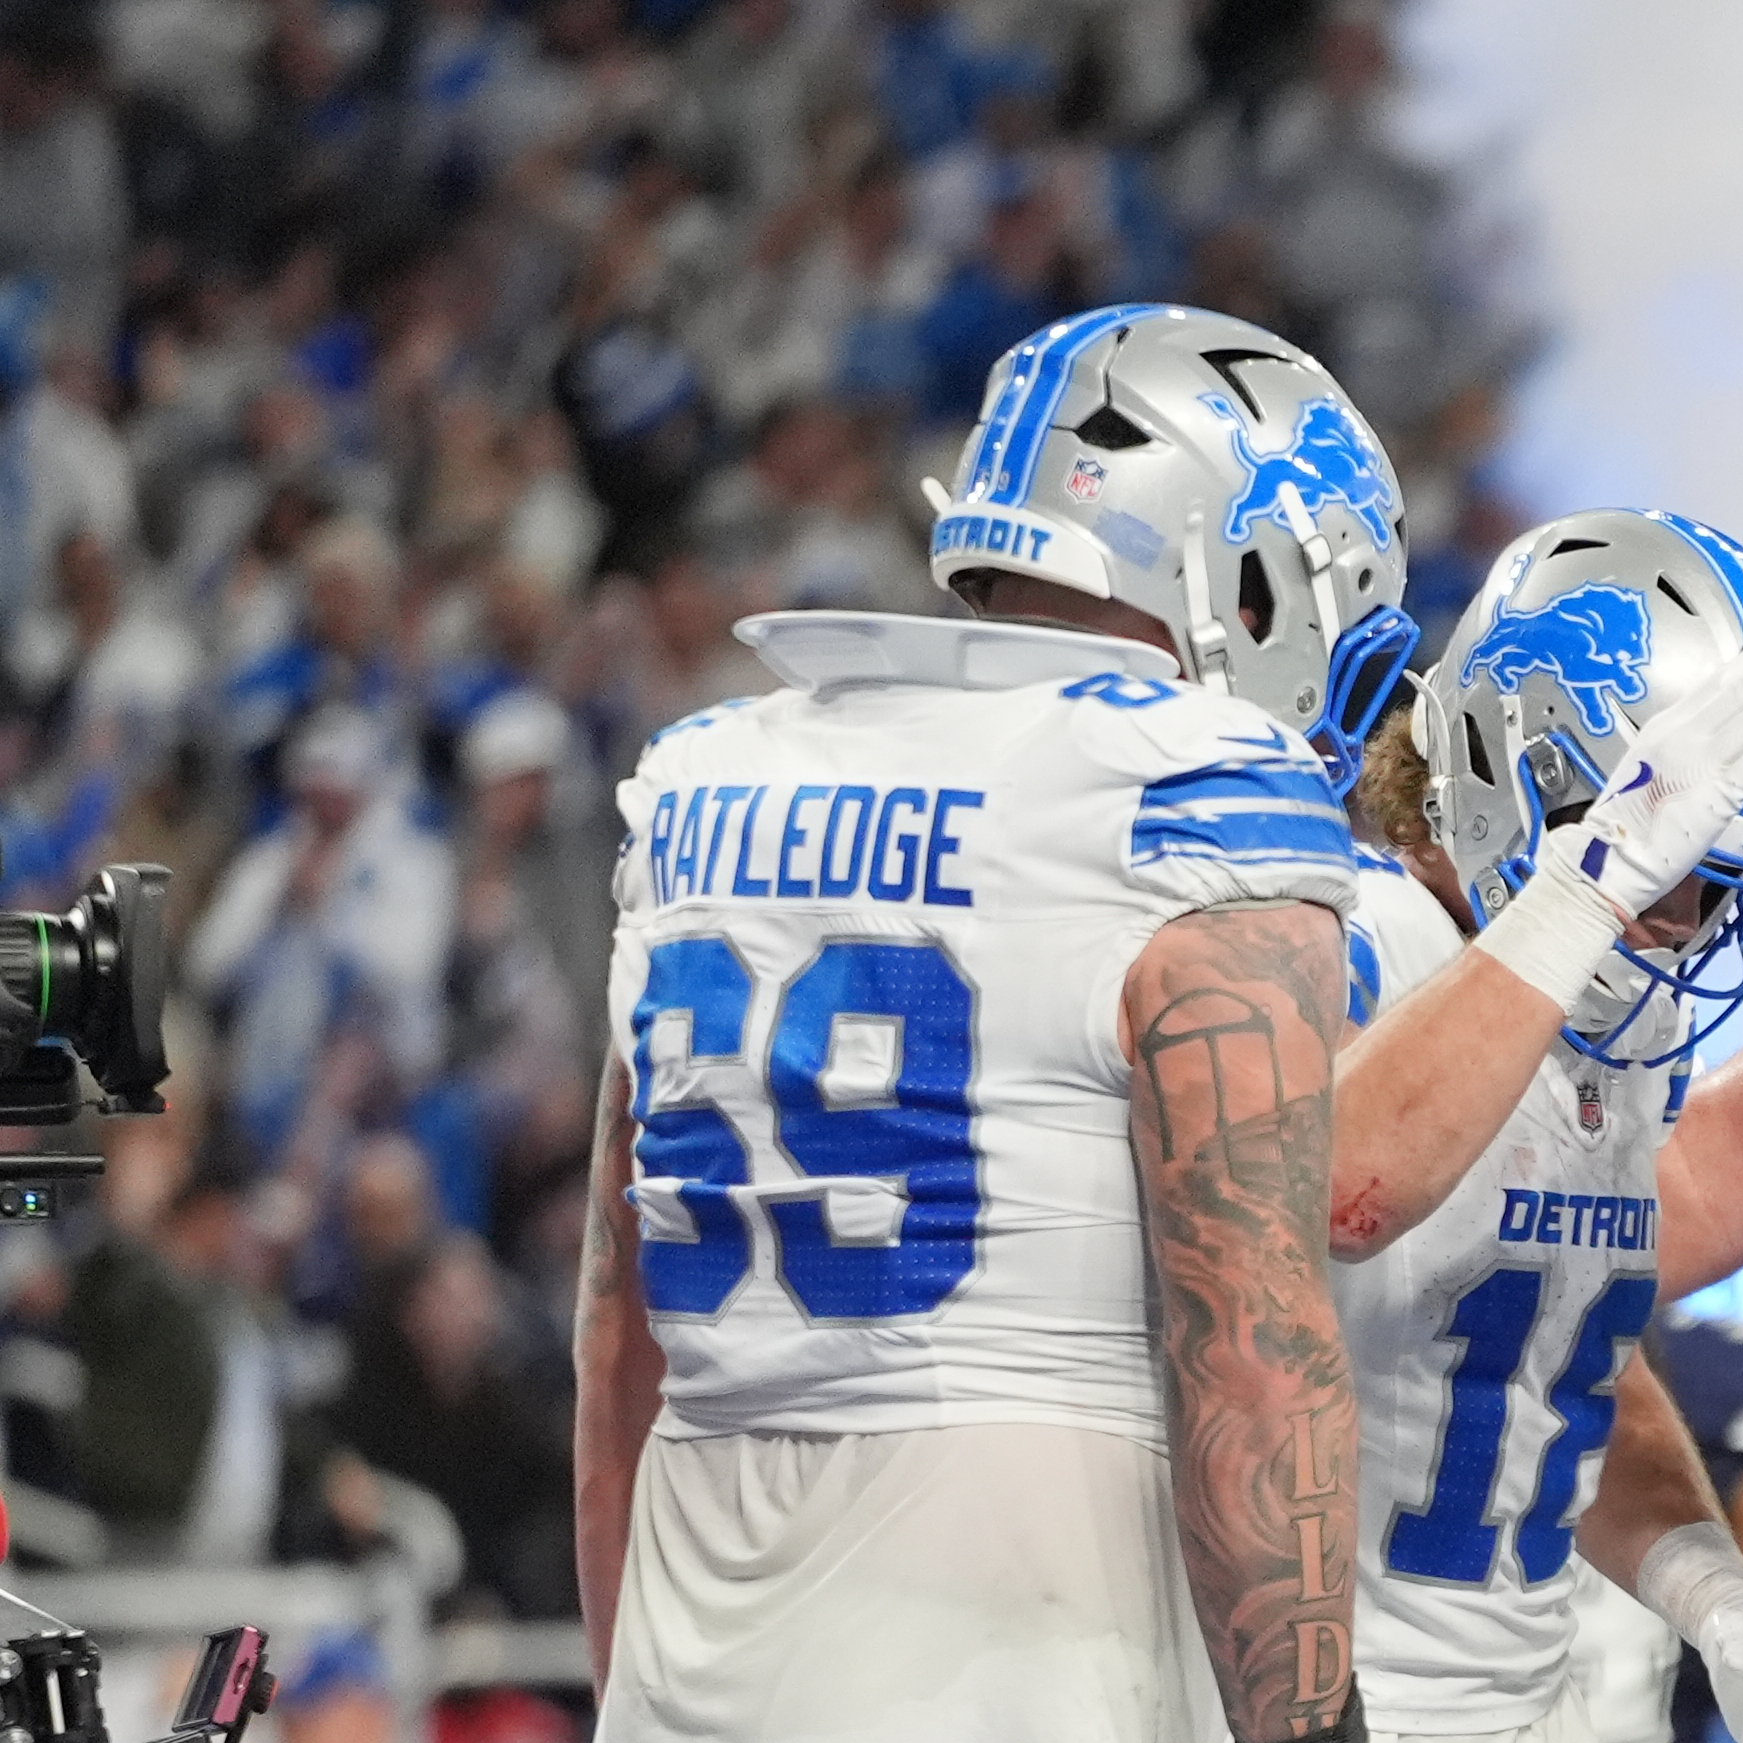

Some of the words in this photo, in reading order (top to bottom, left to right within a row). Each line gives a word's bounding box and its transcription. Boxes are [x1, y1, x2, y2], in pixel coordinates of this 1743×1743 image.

[1070, 473, 1098, 498] NFL
[650, 784, 985, 907] RATLEDGE
[627, 930, 982, 1328] 69
